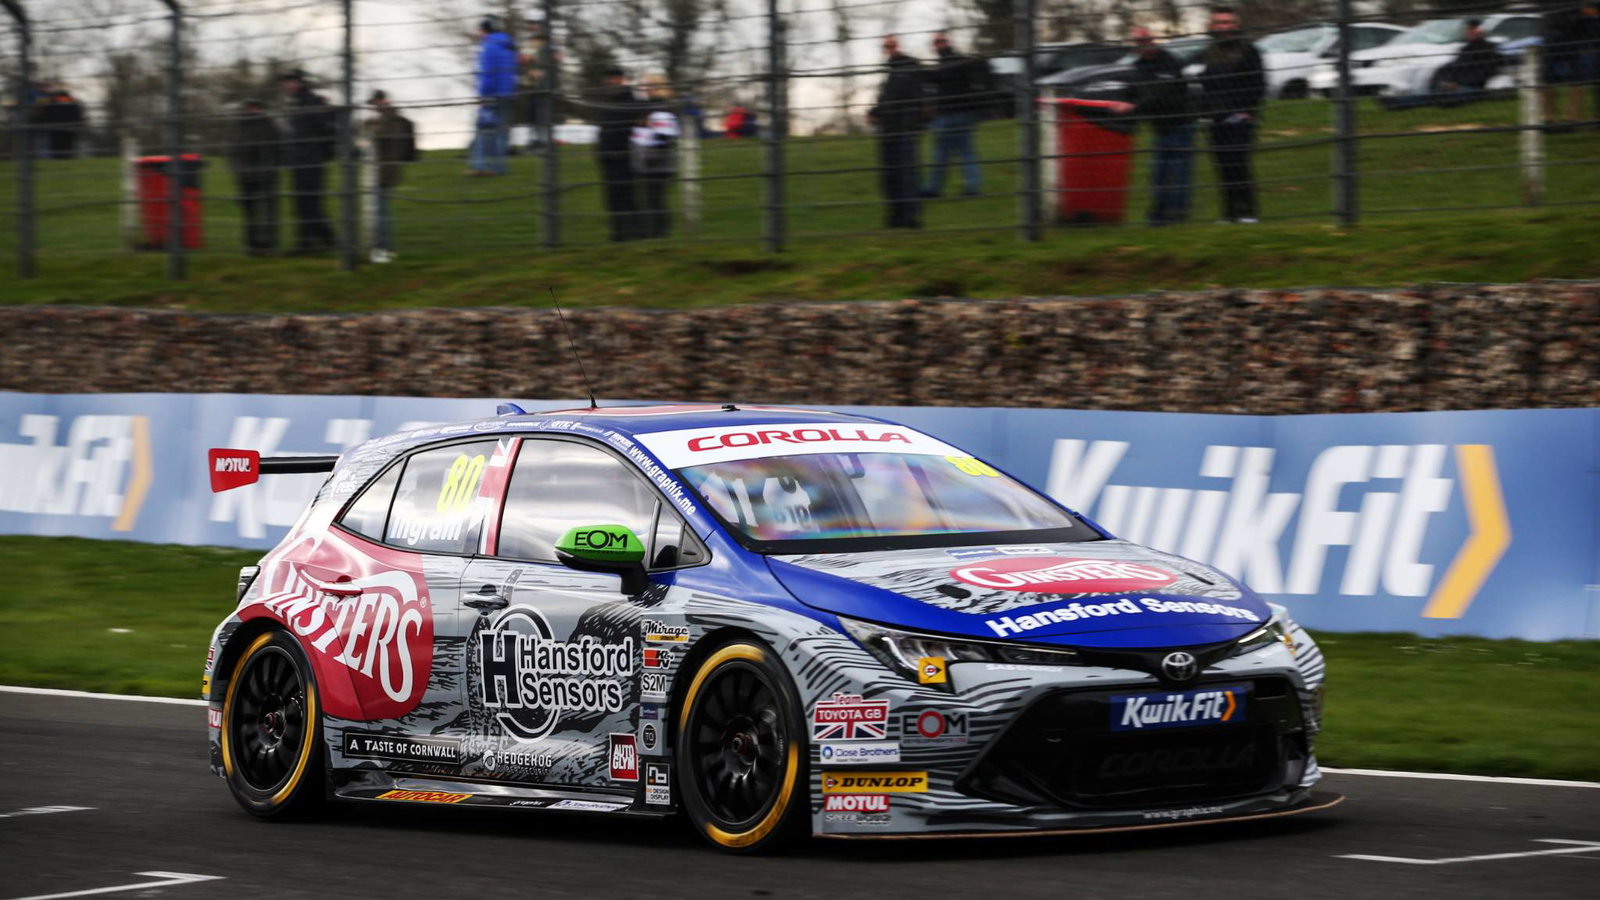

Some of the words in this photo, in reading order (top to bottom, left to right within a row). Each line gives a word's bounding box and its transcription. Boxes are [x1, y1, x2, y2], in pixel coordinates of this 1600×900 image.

[688, 429, 912, 452] COROLLA
[0, 414, 133, 517] ikFit
[215, 457, 251, 473] MOTUL
[437, 454, 486, 513] 80
[629, 446, 696, 516] www.graphix.me
[390, 515, 464, 546] Ingram
[574, 530, 628, 549] EOM
[956, 560, 1171, 587] GINSTERS
[985, 599, 1142, 638] Hansford
[1139, 597, 1261, 622] Sensors
[645, 620, 689, 638] Mirage
[520, 637, 632, 674] Hansford
[522, 672, 622, 711] Sensors
[642, 674, 666, 692] S2M
[834, 694, 862, 704] Team
[818, 709, 863, 720] TOYOTA
[865, 708, 883, 719] GB
[1120, 691, 1225, 728] KwikFit
[903, 711, 966, 738] EOM
[350, 739, 359, 751] A
[365, 740, 394, 753] TASTE
[396, 743, 408, 754] OF
[410, 744, 456, 758] CORNWALL
[614, 744, 635, 759] AUTO
[835, 748, 858, 757] Close
[860, 747, 899, 756] Brothers
[497, 751, 552, 768] HEDGEHOG
[613, 756, 635, 770] GLYM
[840, 777, 923, 787] DUNLOP
[825, 795, 888, 811] MOTUL
